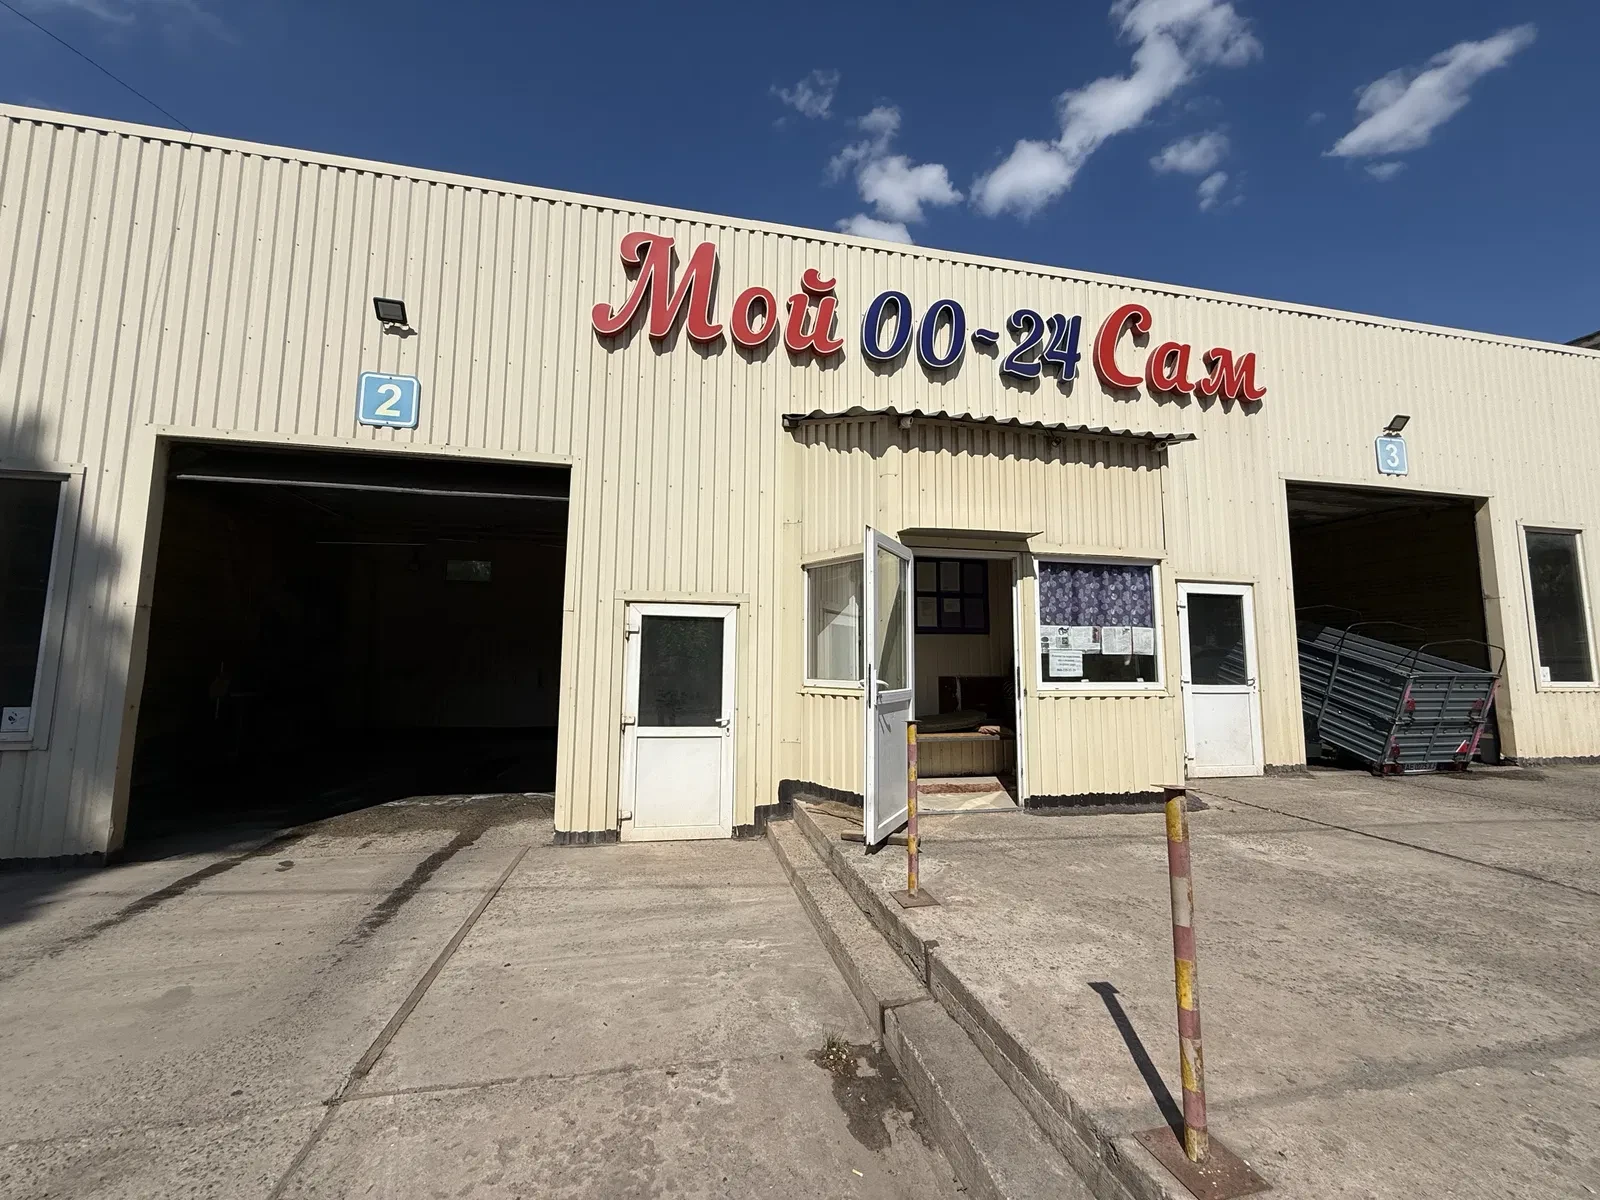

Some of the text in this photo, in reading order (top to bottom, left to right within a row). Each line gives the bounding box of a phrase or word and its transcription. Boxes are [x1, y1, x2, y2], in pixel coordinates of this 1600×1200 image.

[591, 231, 1267, 400] Мой 00-24 Сам
[374, 383, 402, 417] 2
[1385, 443, 1400, 468] 3
